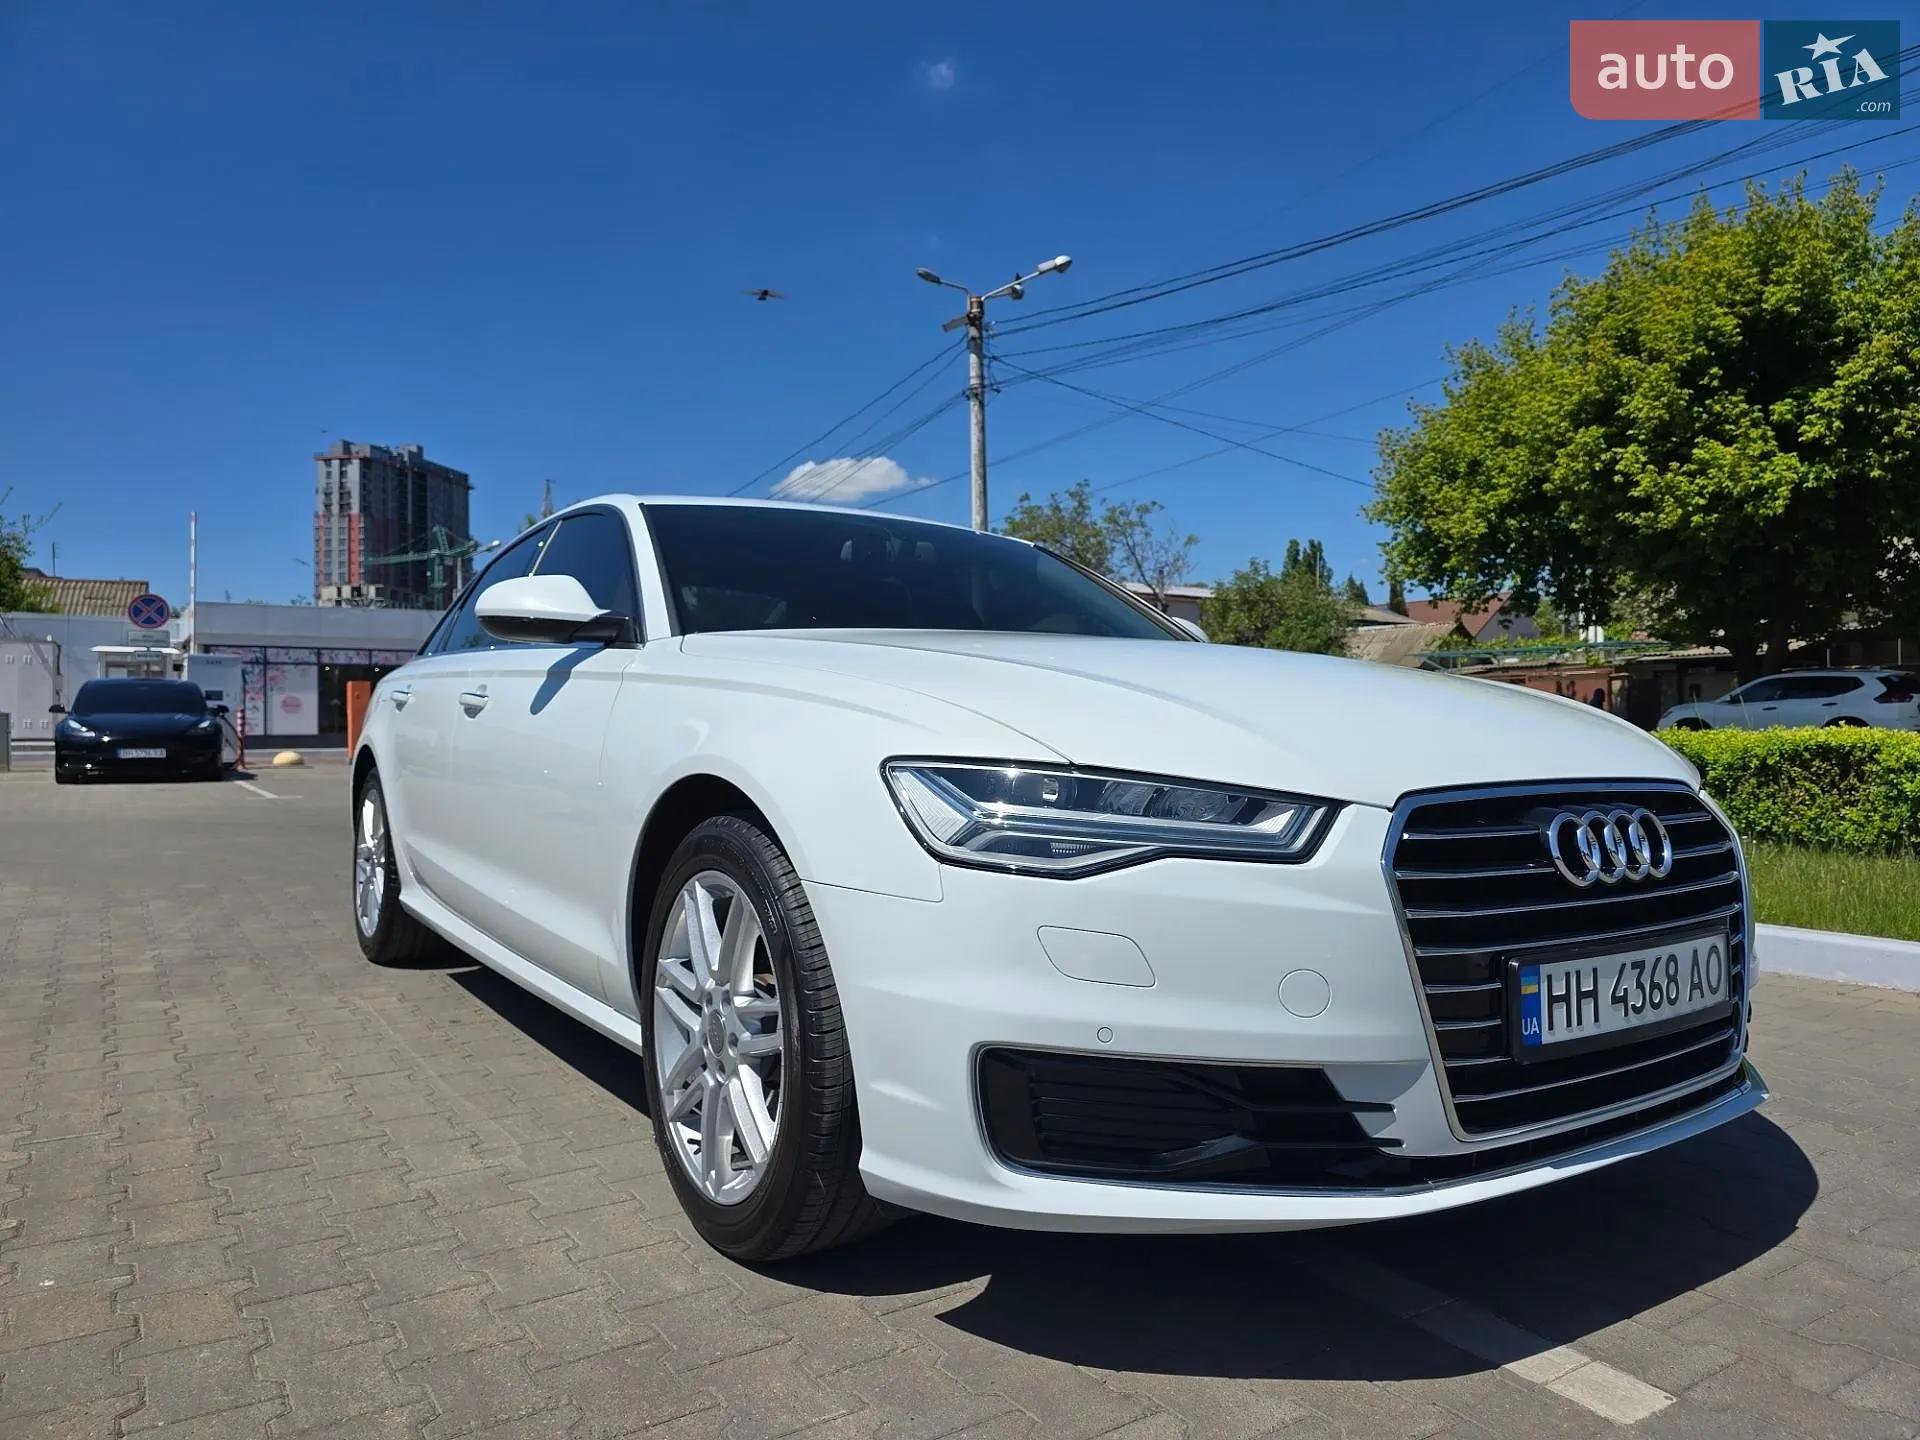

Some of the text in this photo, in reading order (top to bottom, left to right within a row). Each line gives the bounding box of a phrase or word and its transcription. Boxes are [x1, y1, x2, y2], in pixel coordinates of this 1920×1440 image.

[1546, 944, 1723, 1032] HH 4368 AO
[1522, 1017, 1541, 1036] UA
